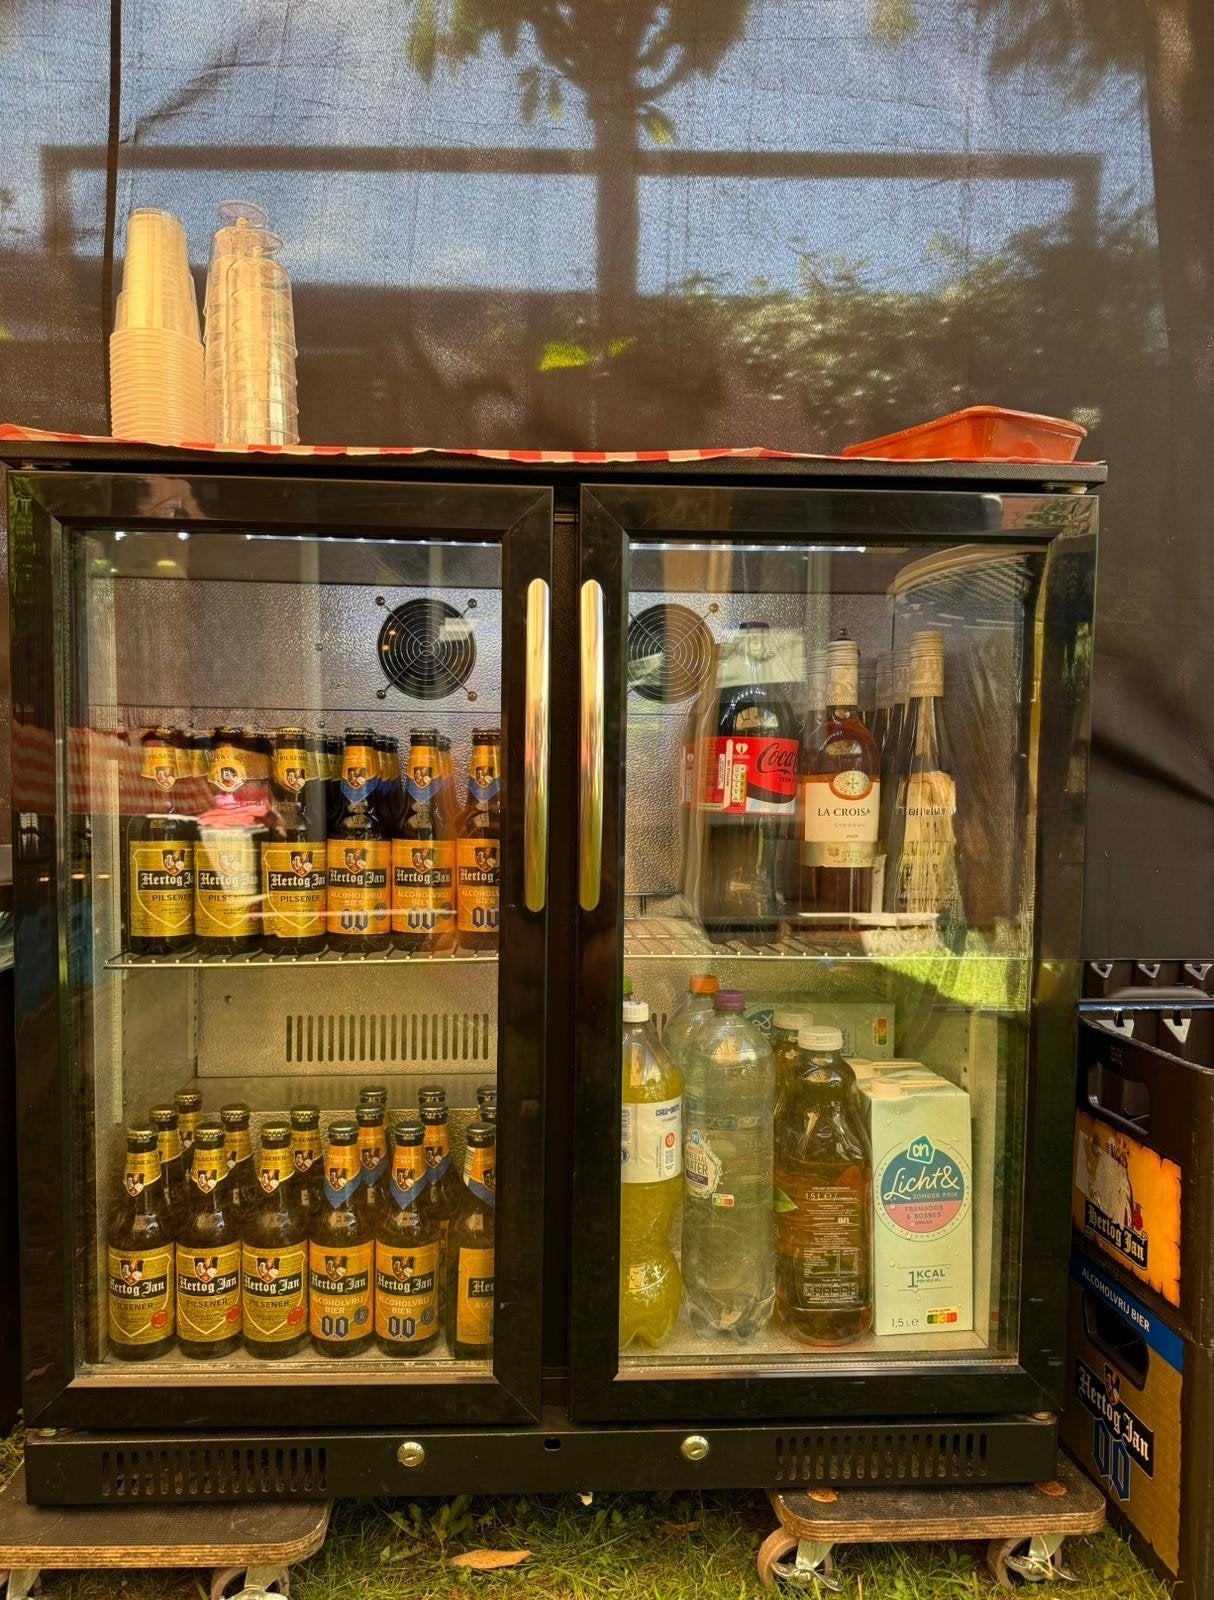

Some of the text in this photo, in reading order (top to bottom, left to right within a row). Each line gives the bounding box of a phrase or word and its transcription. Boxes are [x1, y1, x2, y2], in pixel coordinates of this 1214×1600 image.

[756, 742, 796, 775] Coca
[817, 808, 831, 816] LA
[141, 873, 183, 888] Hertog
[200, 872, 239, 888] Hertog
[270, 873, 310, 889] Hertog
[330, 869, 385, 886] Hertog Jan
[396, 869, 451, 886] Hertog Jan
[460, 869, 494, 883] Hertog
[280, 895, 321, 903] PILSENER
[1087, 1203, 1145, 1262] Hertog Jan
[110, 1276, 165, 1297] Hertog Jan
[179, 1275, 237, 1294] Hertog Jan
[244, 1276, 300, 1295] Hertog Jan
[311, 1273, 366, 1293] Hertog Jan
[376, 1273, 432, 1293] Hertog Jan
[907, 1269, 946, 1289] 1 KCAL
[185, 1299, 228, 1308] PILSENER
[249, 1299, 290, 1308] PILSENER
[311, 1295, 364, 1307] ALCOHOLVRIJ
[378, 1295, 431, 1307] ALCOHOLVRIJ
[1081, 1267, 1151, 1334] ALCOHOLVRIJ BIER
[324, 1306, 345, 1315] BIER
[390, 1306, 412, 1315] BIER
[891, 1318, 904, 1328] 1,5
[1077, 1365, 1150, 1462] Hertog Jan
